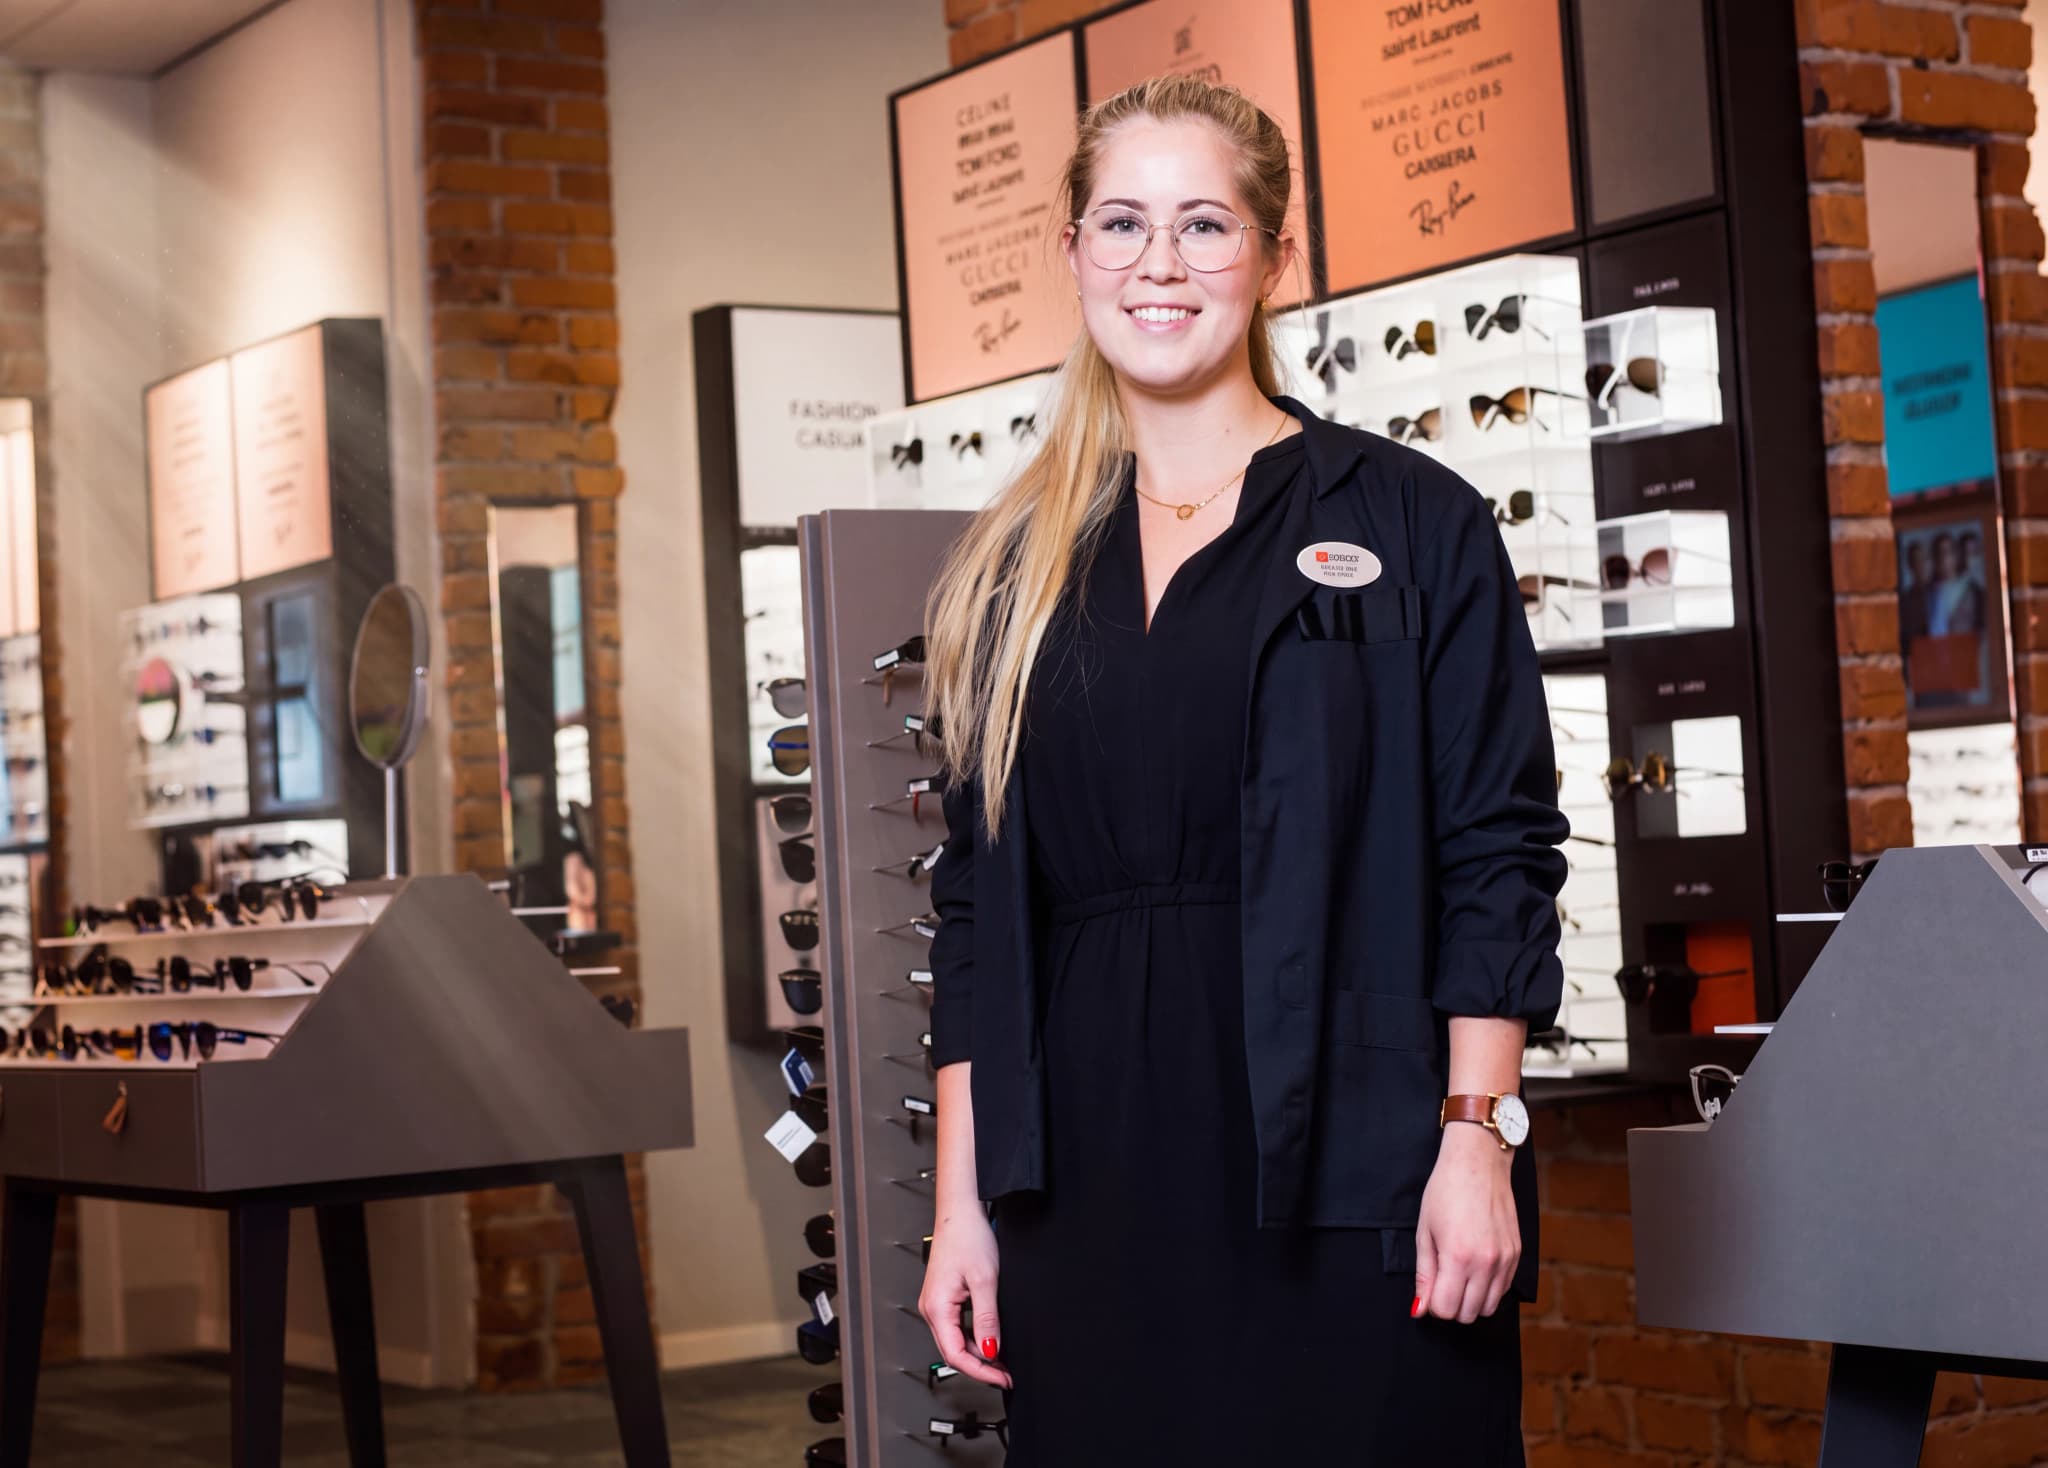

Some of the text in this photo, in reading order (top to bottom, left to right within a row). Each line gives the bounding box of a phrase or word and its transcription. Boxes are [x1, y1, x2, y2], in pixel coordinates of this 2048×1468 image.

[1385, 0, 1475, 30] TOM FO
[1371, 102, 1421, 132] MARC
[1430, 79, 1503, 117] JACOBS
[1392, 109, 1486, 157] GUCCI
[796, 428, 865, 449] CASUA
